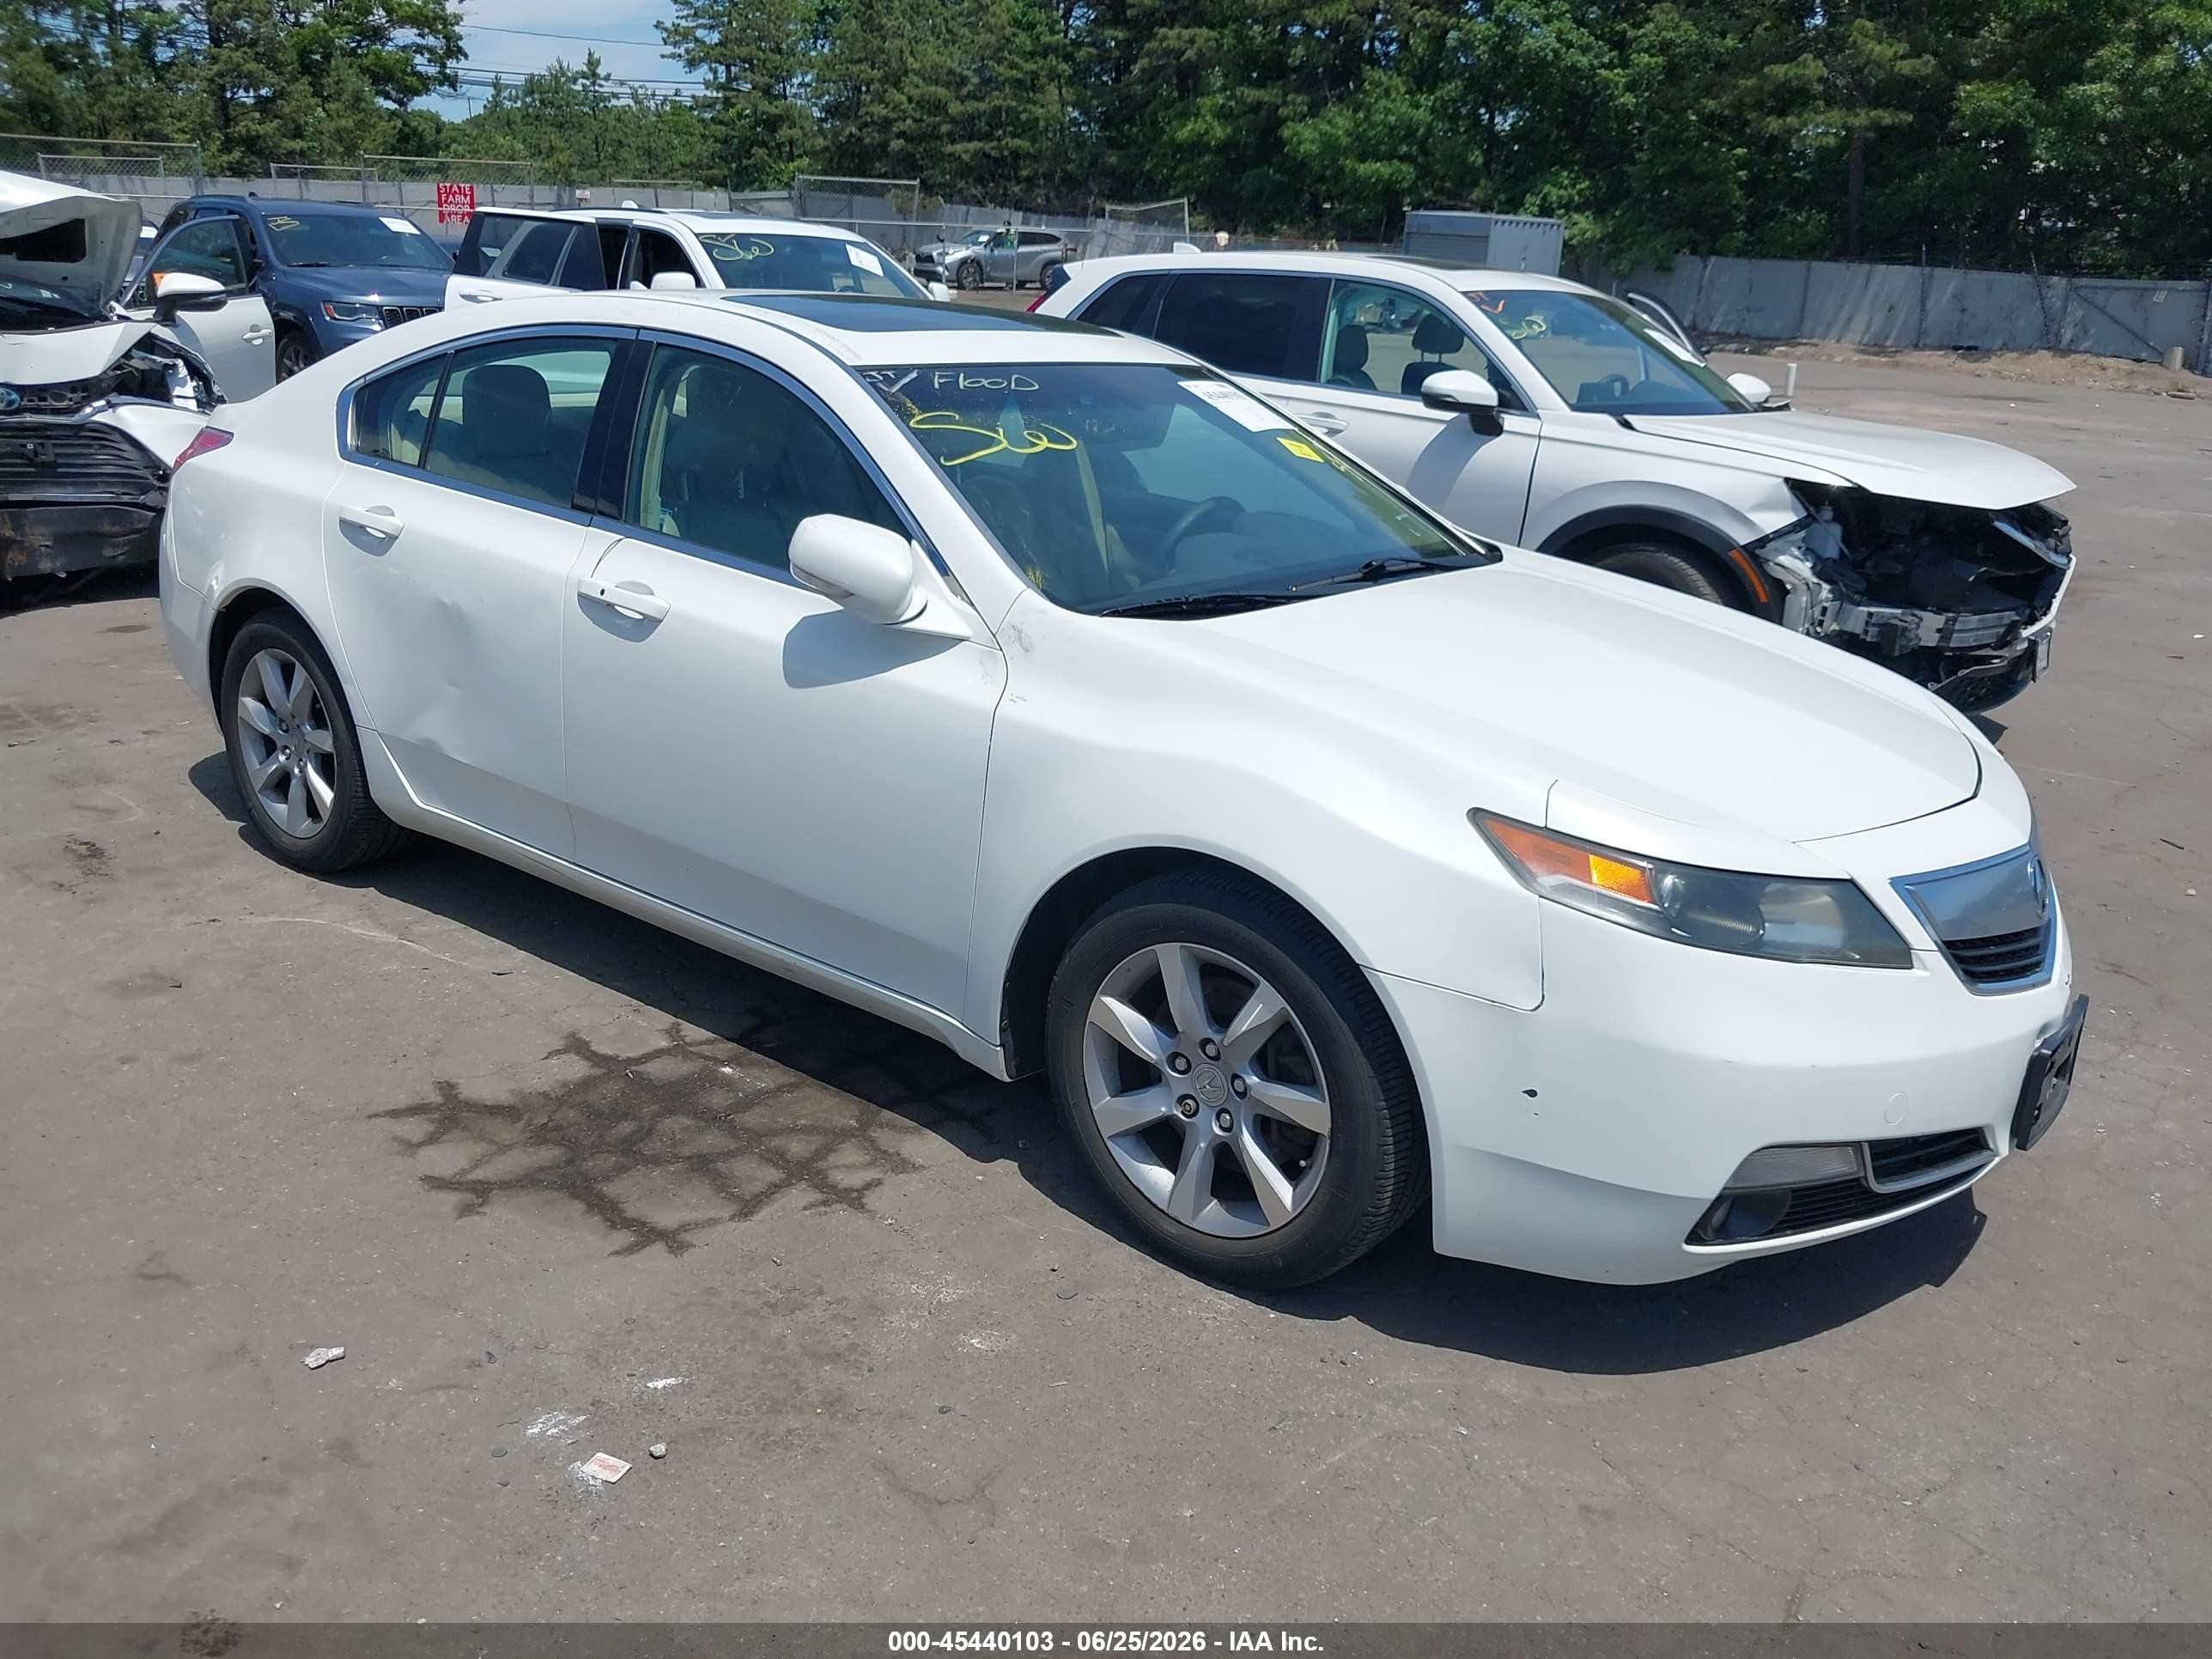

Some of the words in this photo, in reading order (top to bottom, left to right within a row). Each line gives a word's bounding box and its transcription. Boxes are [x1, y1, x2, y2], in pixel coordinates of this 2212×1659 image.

[439, 183, 471, 194] STATE
[441, 194, 471, 204] FARM
[442, 204, 471, 215] DROP
[443, 215, 471, 225] AREA
